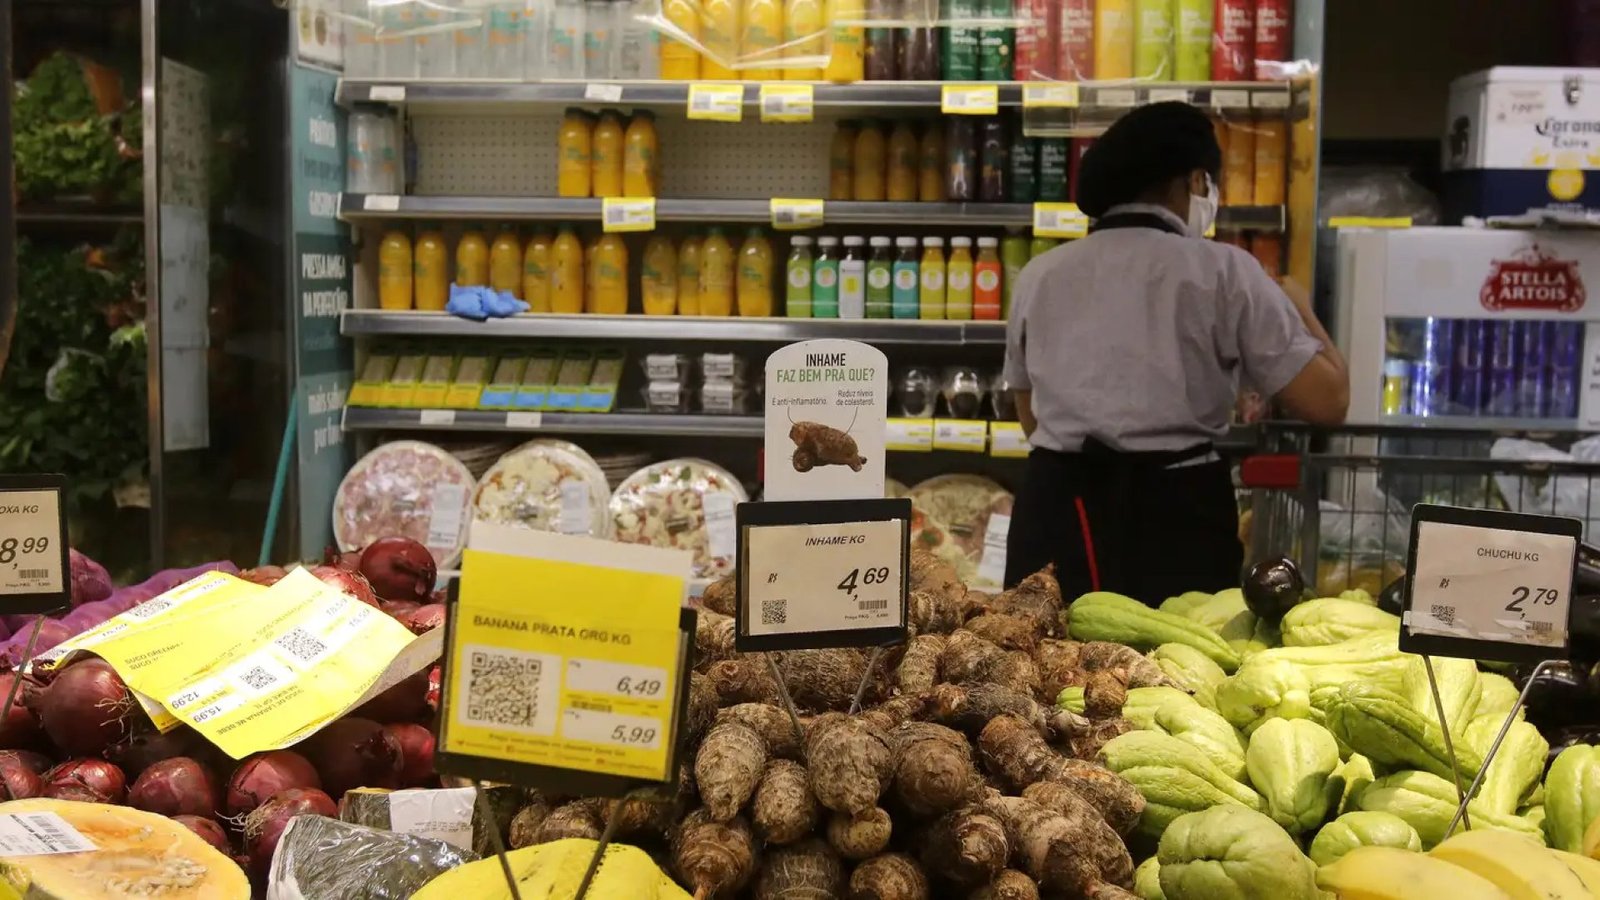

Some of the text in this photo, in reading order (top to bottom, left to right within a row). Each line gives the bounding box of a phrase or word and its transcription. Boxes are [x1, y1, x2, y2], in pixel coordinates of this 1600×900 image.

[1501, 271, 1566, 286] STELLA
[1500, 286, 1567, 301] ARTOIS
[806, 353, 846, 367] INHAME
[776, 367, 875, 383] FAZ BEM PRA QUE?
[838, 389, 855, 398] Reduz
[835, 398, 844, 406] de
[22, 505, 39, 514] KG
[805, 534, 866, 547] INHAME KG
[0, 537, 49, 570] 8,99
[1477, 547, 1540, 562] CHUCHU KG
[837, 567, 890, 601] 4,69
[1505, 586, 1558, 620] 2,79
[473, 615, 528, 632] BANANA
[532, 623, 576, 638] PRATA
[611, 632, 631, 645] KG
[124, 652, 147, 666] SUCO
[129, 658, 151, 671] SUCO
[616, 675, 661, 696] 6,49
[171, 690, 200, 709] 12,99
[274, 697, 286, 707] DE
[193, 704, 222, 723] 15,99
[245, 701, 276, 723] LARANJA
[234, 716, 247, 727] ME
[215, 721, 236, 738] BEBE
[611, 724, 656, 744] 5,99
